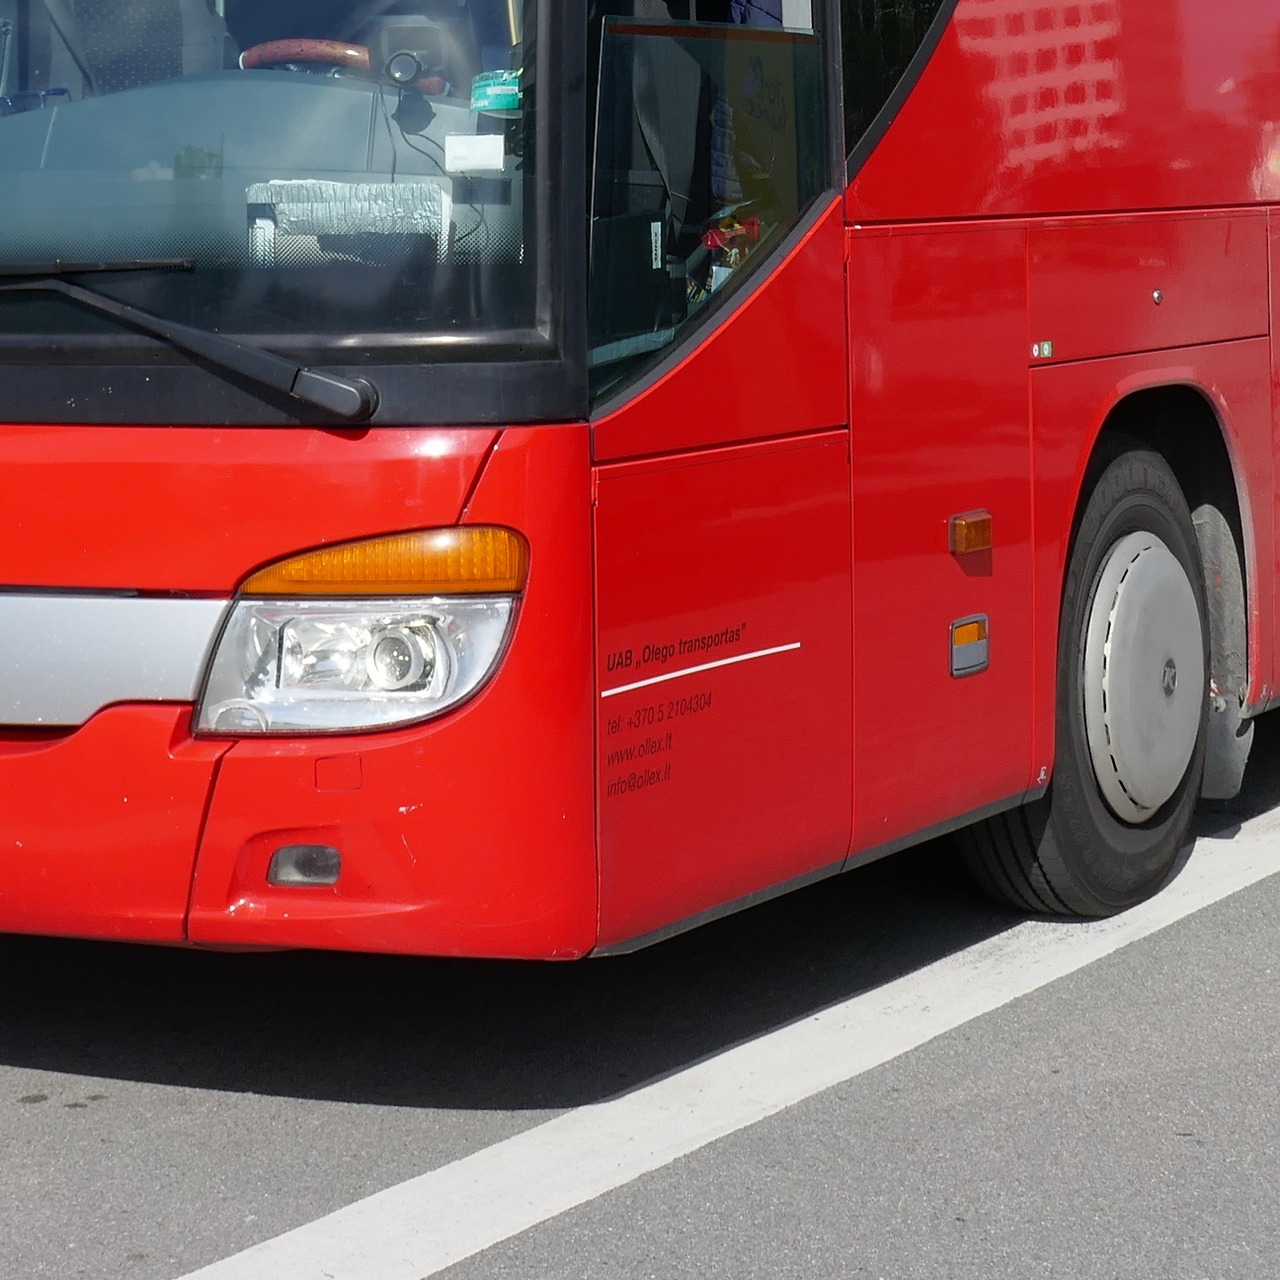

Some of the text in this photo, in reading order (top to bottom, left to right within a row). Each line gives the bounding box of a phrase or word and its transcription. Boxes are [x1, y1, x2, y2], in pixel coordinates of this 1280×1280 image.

[607, 649, 633, 671] UAB
[627, 706, 655, 730] +370
[657, 703, 665, 723] 5
[607, 732, 673, 767] www.ollex.lt
[607, 763, 672, 798] info@ollex.lt
